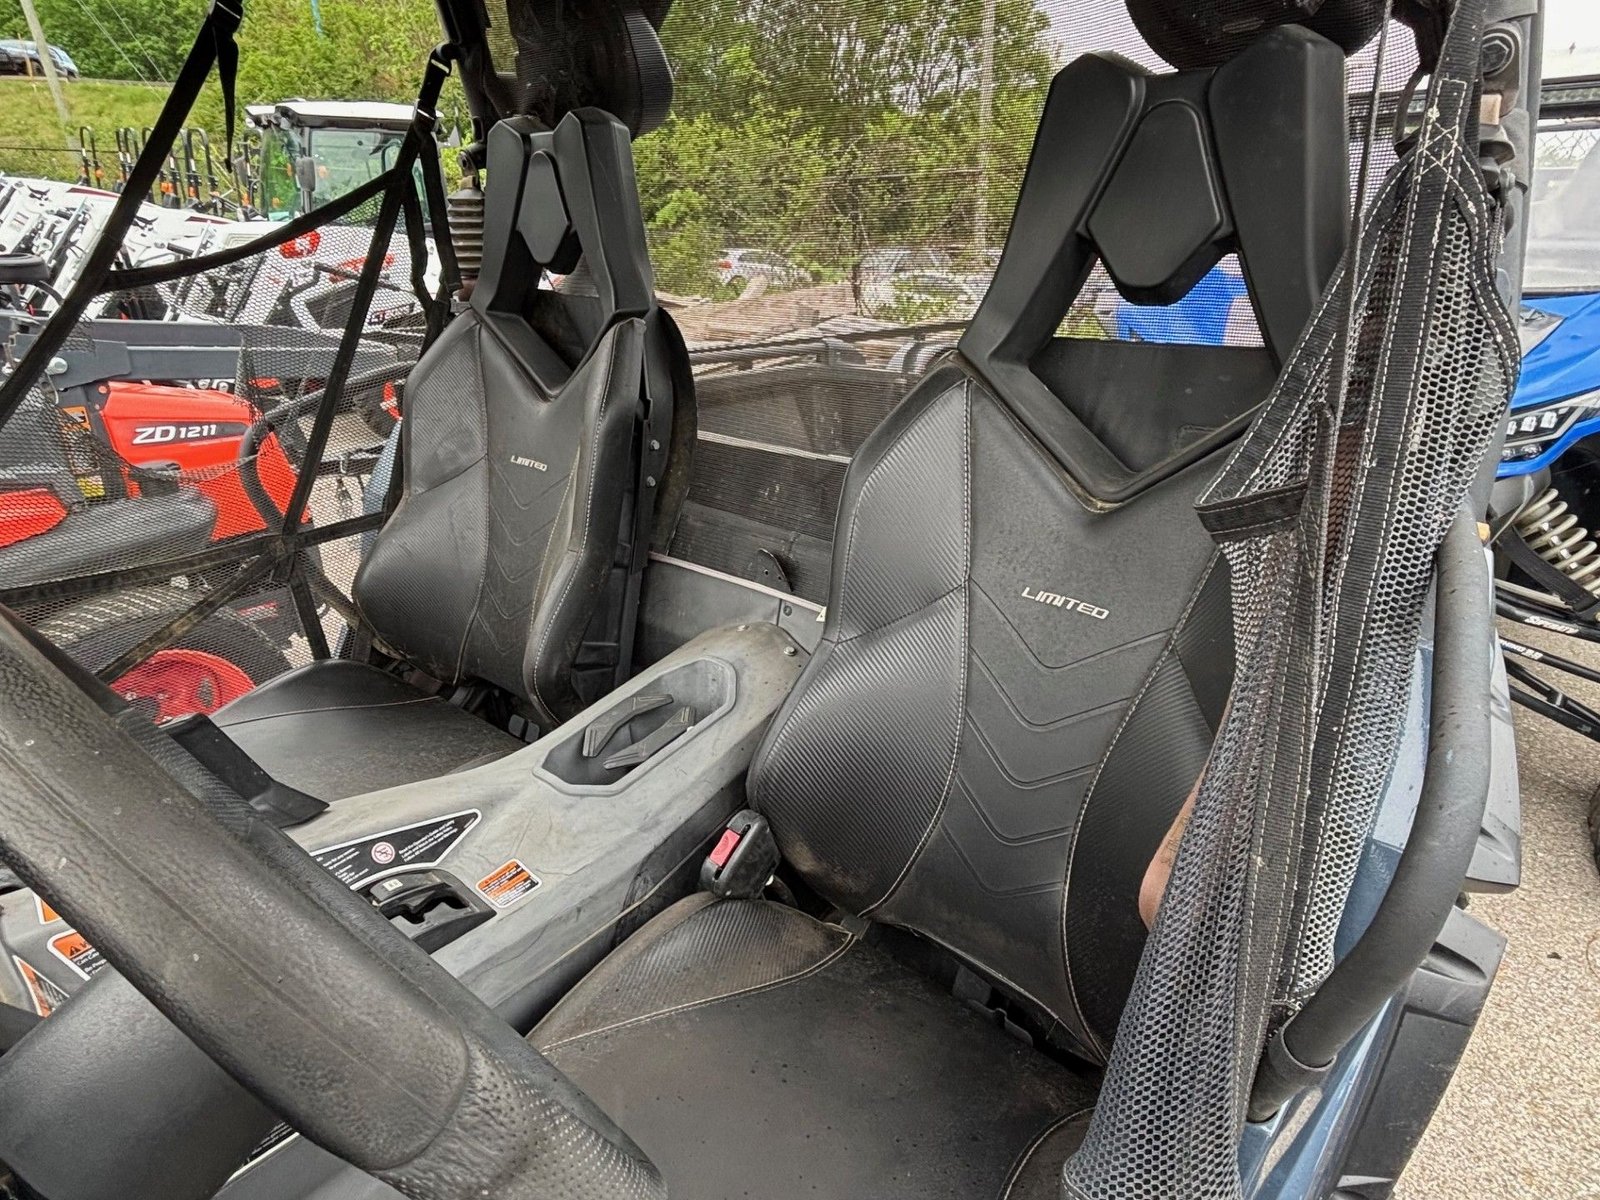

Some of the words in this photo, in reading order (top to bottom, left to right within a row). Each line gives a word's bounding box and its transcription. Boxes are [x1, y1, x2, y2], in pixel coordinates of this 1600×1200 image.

[132, 425, 177, 444] ZD
[179, 424, 217, 439] 1211
[510, 455, 548, 472] LIMITED
[1021, 586, 1110, 620] LIMITED
